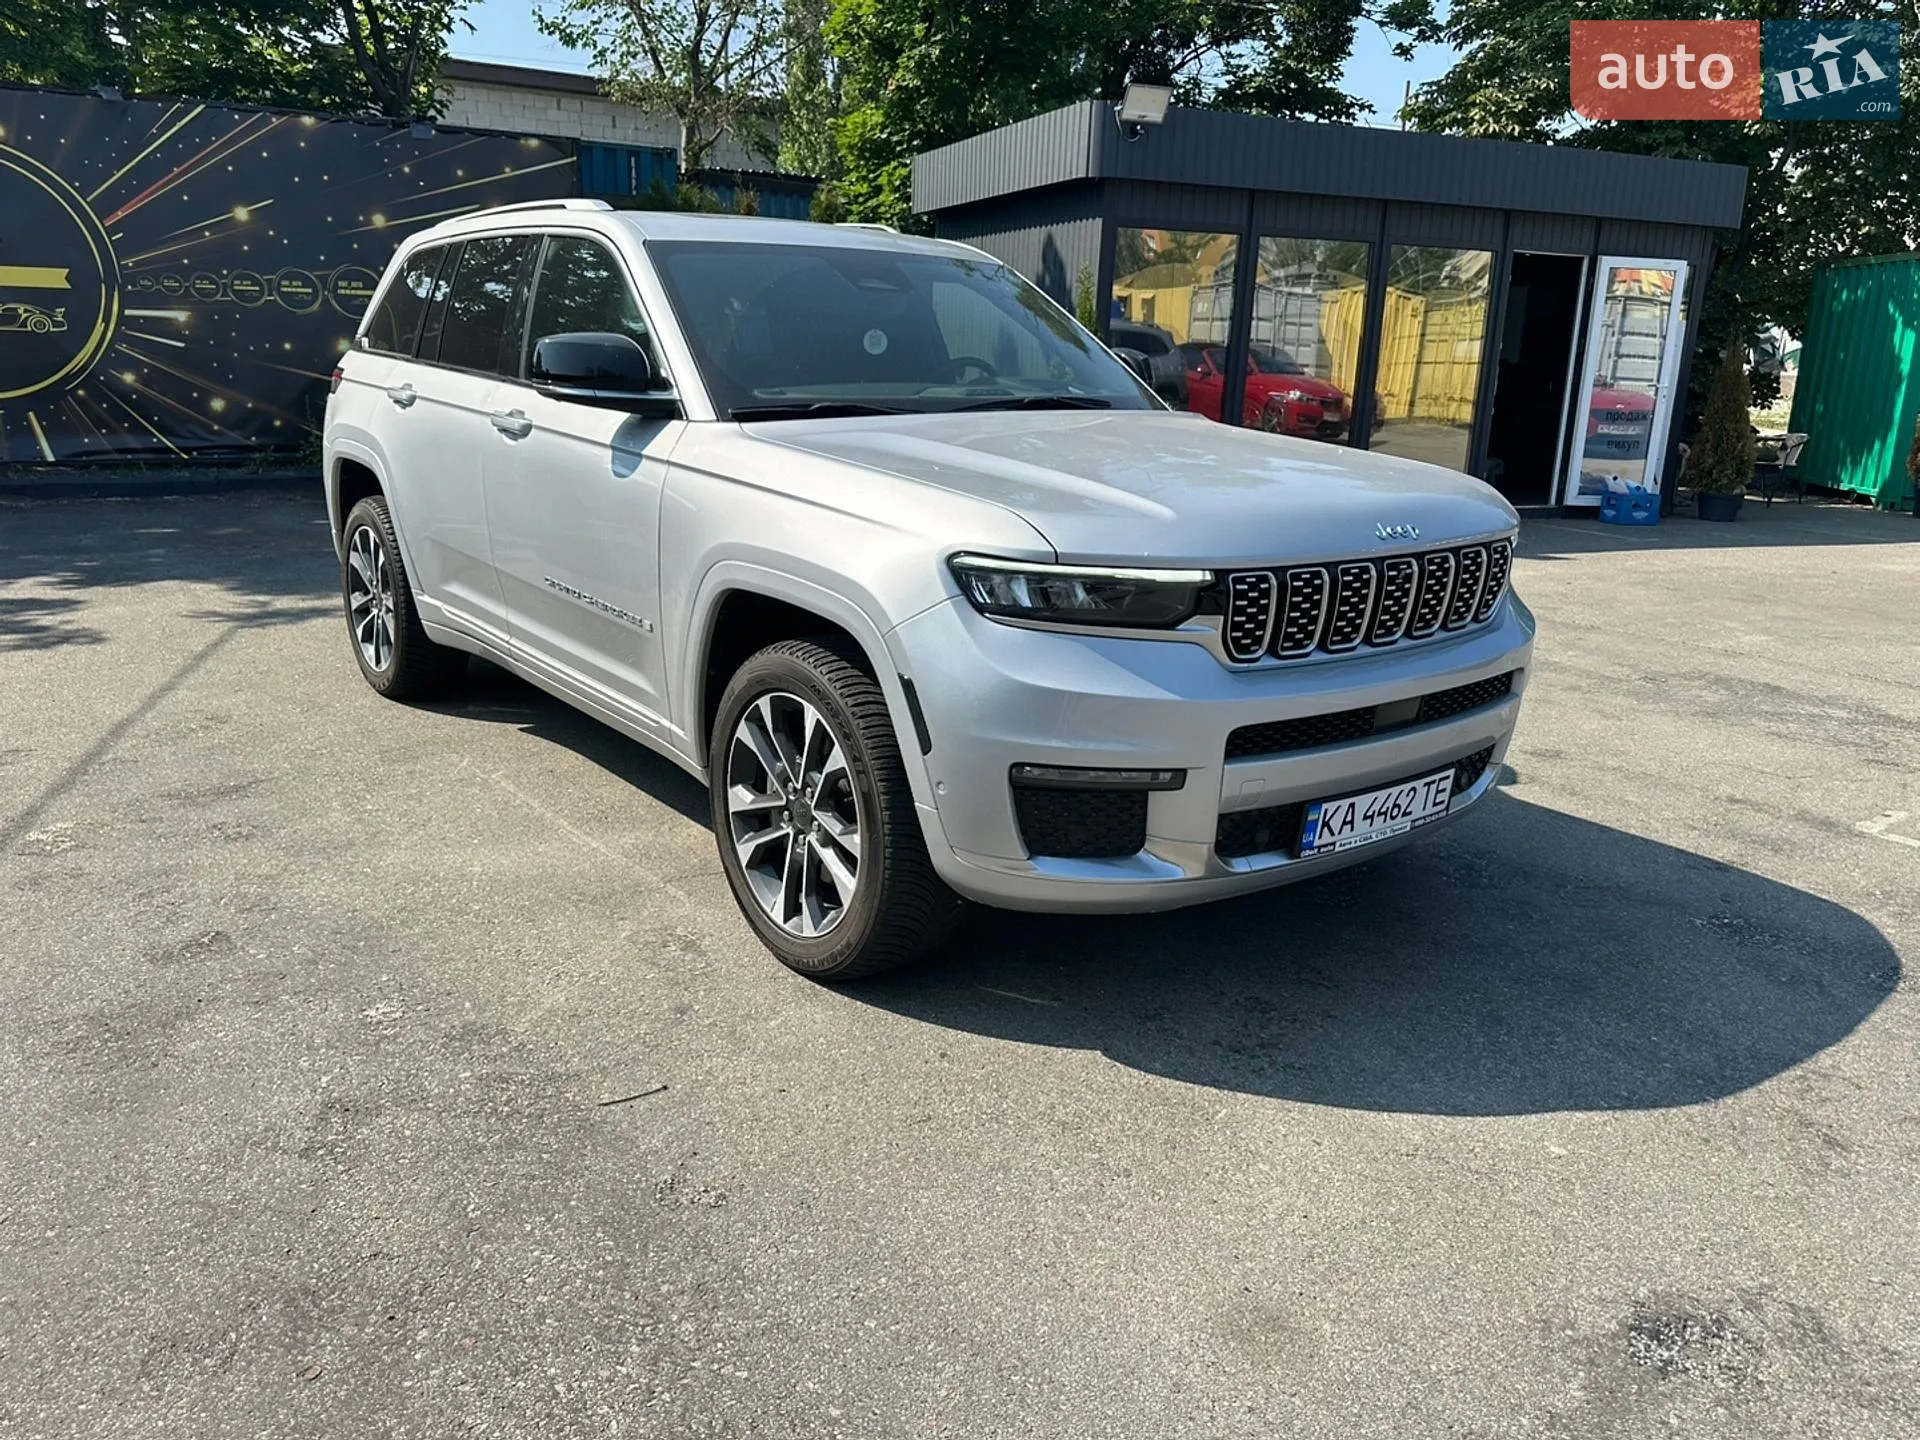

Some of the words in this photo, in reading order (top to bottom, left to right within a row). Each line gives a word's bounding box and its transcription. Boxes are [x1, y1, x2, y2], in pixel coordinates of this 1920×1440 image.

[1605, 411, 1649, 424] продаж
[1607, 440, 1639, 452] викуп
[1375, 522, 1420, 541] Jeep
[1318, 803, 1356, 839] KA
[1362, 787, 1418, 828] 4462
[1422, 775, 1451, 812] TE
